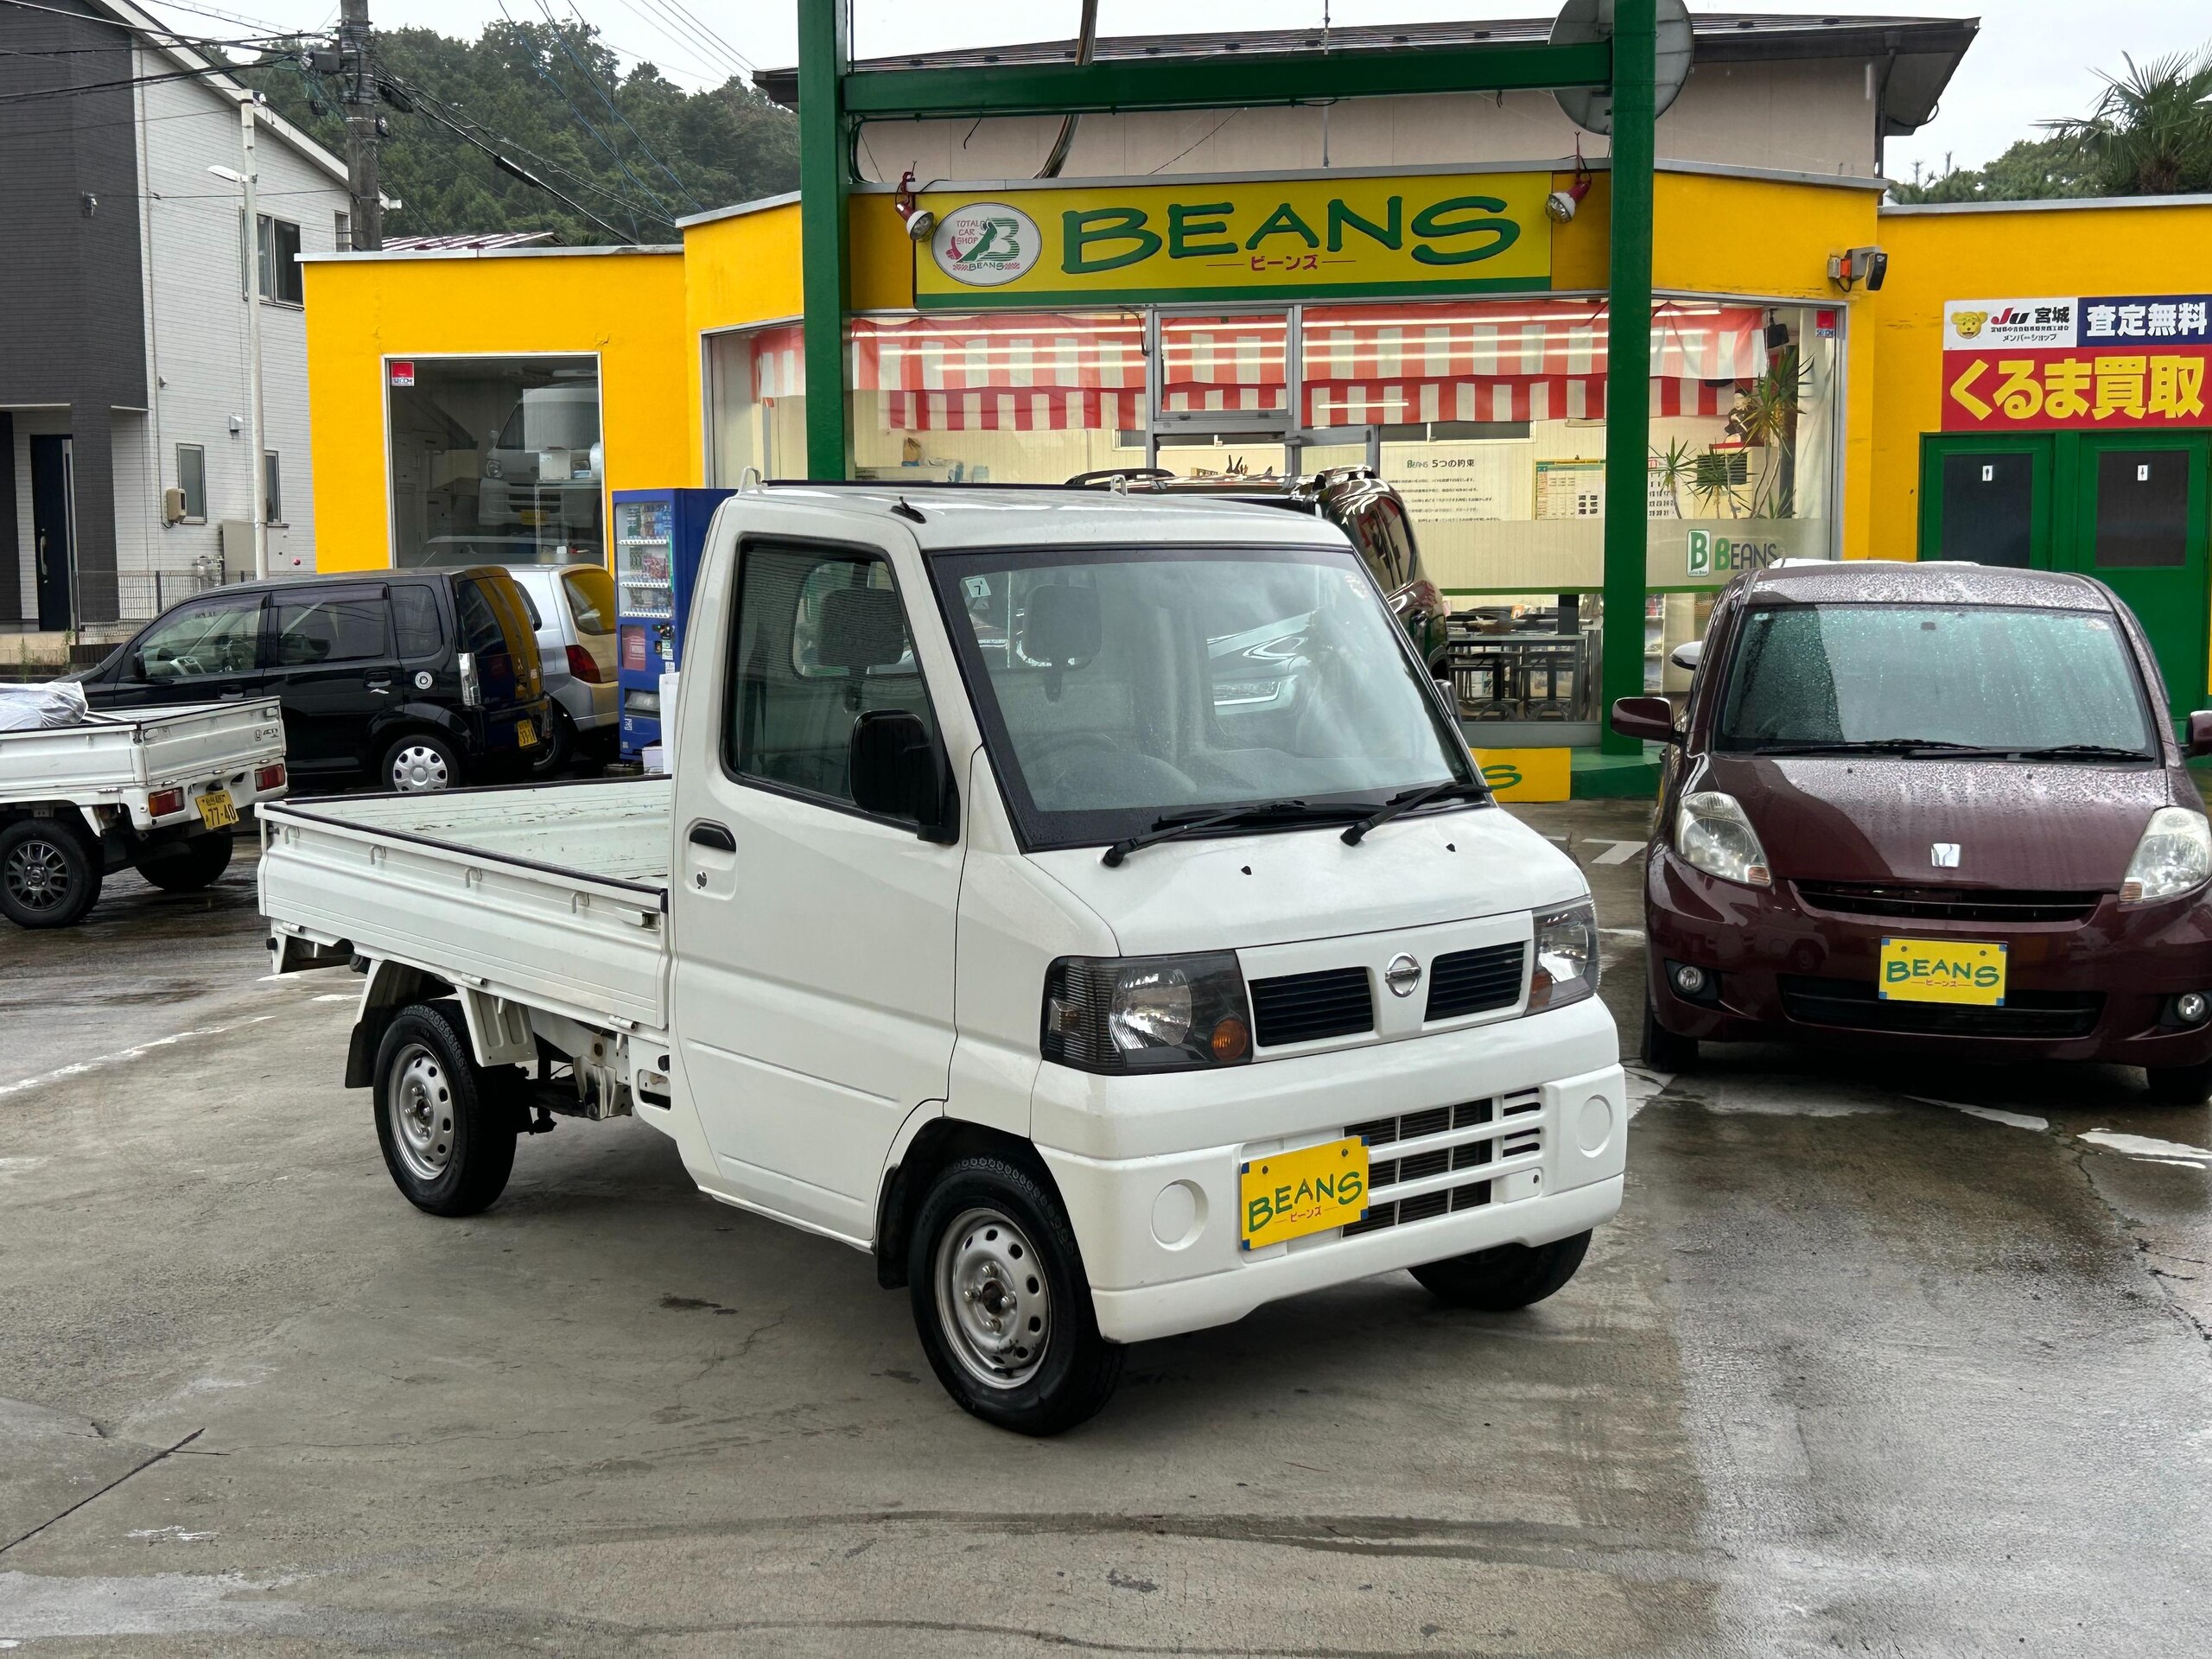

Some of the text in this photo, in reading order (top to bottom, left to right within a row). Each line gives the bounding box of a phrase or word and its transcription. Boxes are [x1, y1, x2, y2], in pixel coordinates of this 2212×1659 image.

[1062, 195, 1521, 274] BEANS
[969, 262, 1004, 271] BEANS
[1250, 254, 1318, 271] ビーンズ
[2034, 306, 2070, 324] 宮城
[2087, 302, 2207, 337] 査定無料
[2003, 334, 2057, 342] メンバーショップ
[1949, 355, 2205, 421] くるま買取
[1714, 537, 1777, 570] BEANS
[1886, 958, 1999, 988] BEANS
[1248, 1171, 1363, 1233] BEANS
[1290, 1205, 1322, 1223] ビーンズ
